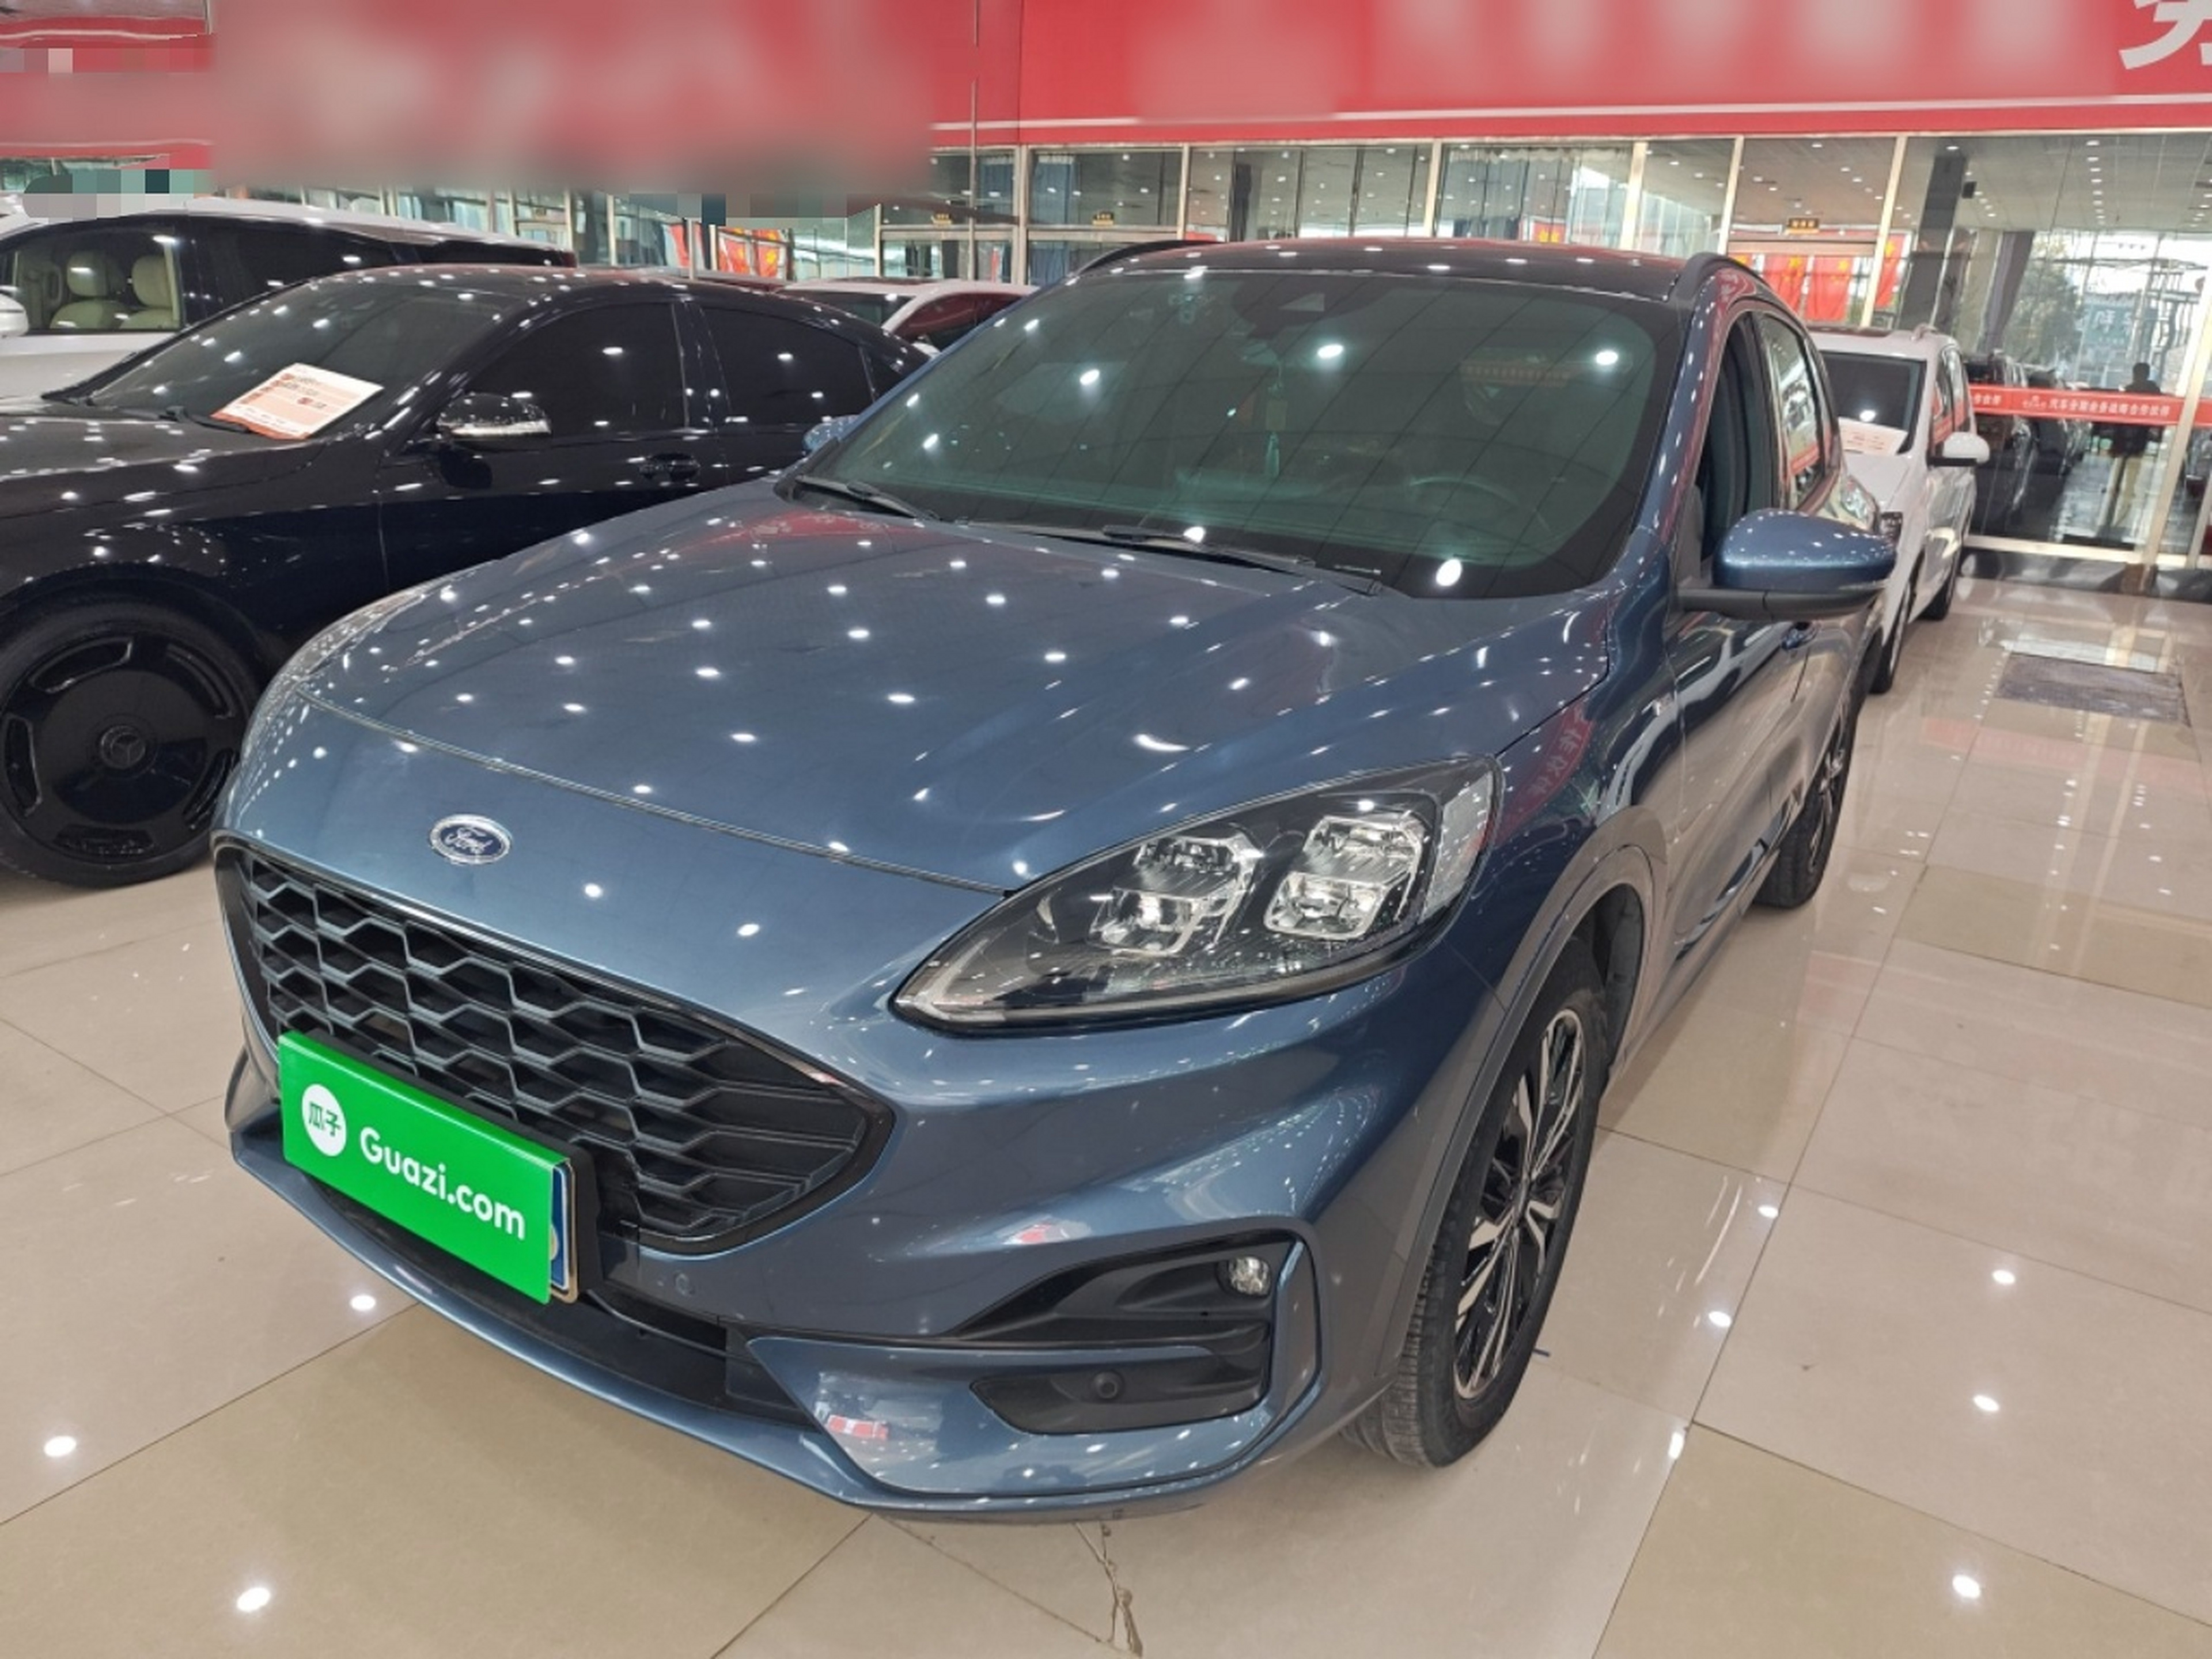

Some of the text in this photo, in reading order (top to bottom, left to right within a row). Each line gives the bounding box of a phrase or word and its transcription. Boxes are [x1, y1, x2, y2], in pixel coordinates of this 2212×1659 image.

[444, 827, 494, 854] Ford
[308, 1100, 342, 1138] 瓜子
[359, 1126, 527, 1241] Guazi.com
